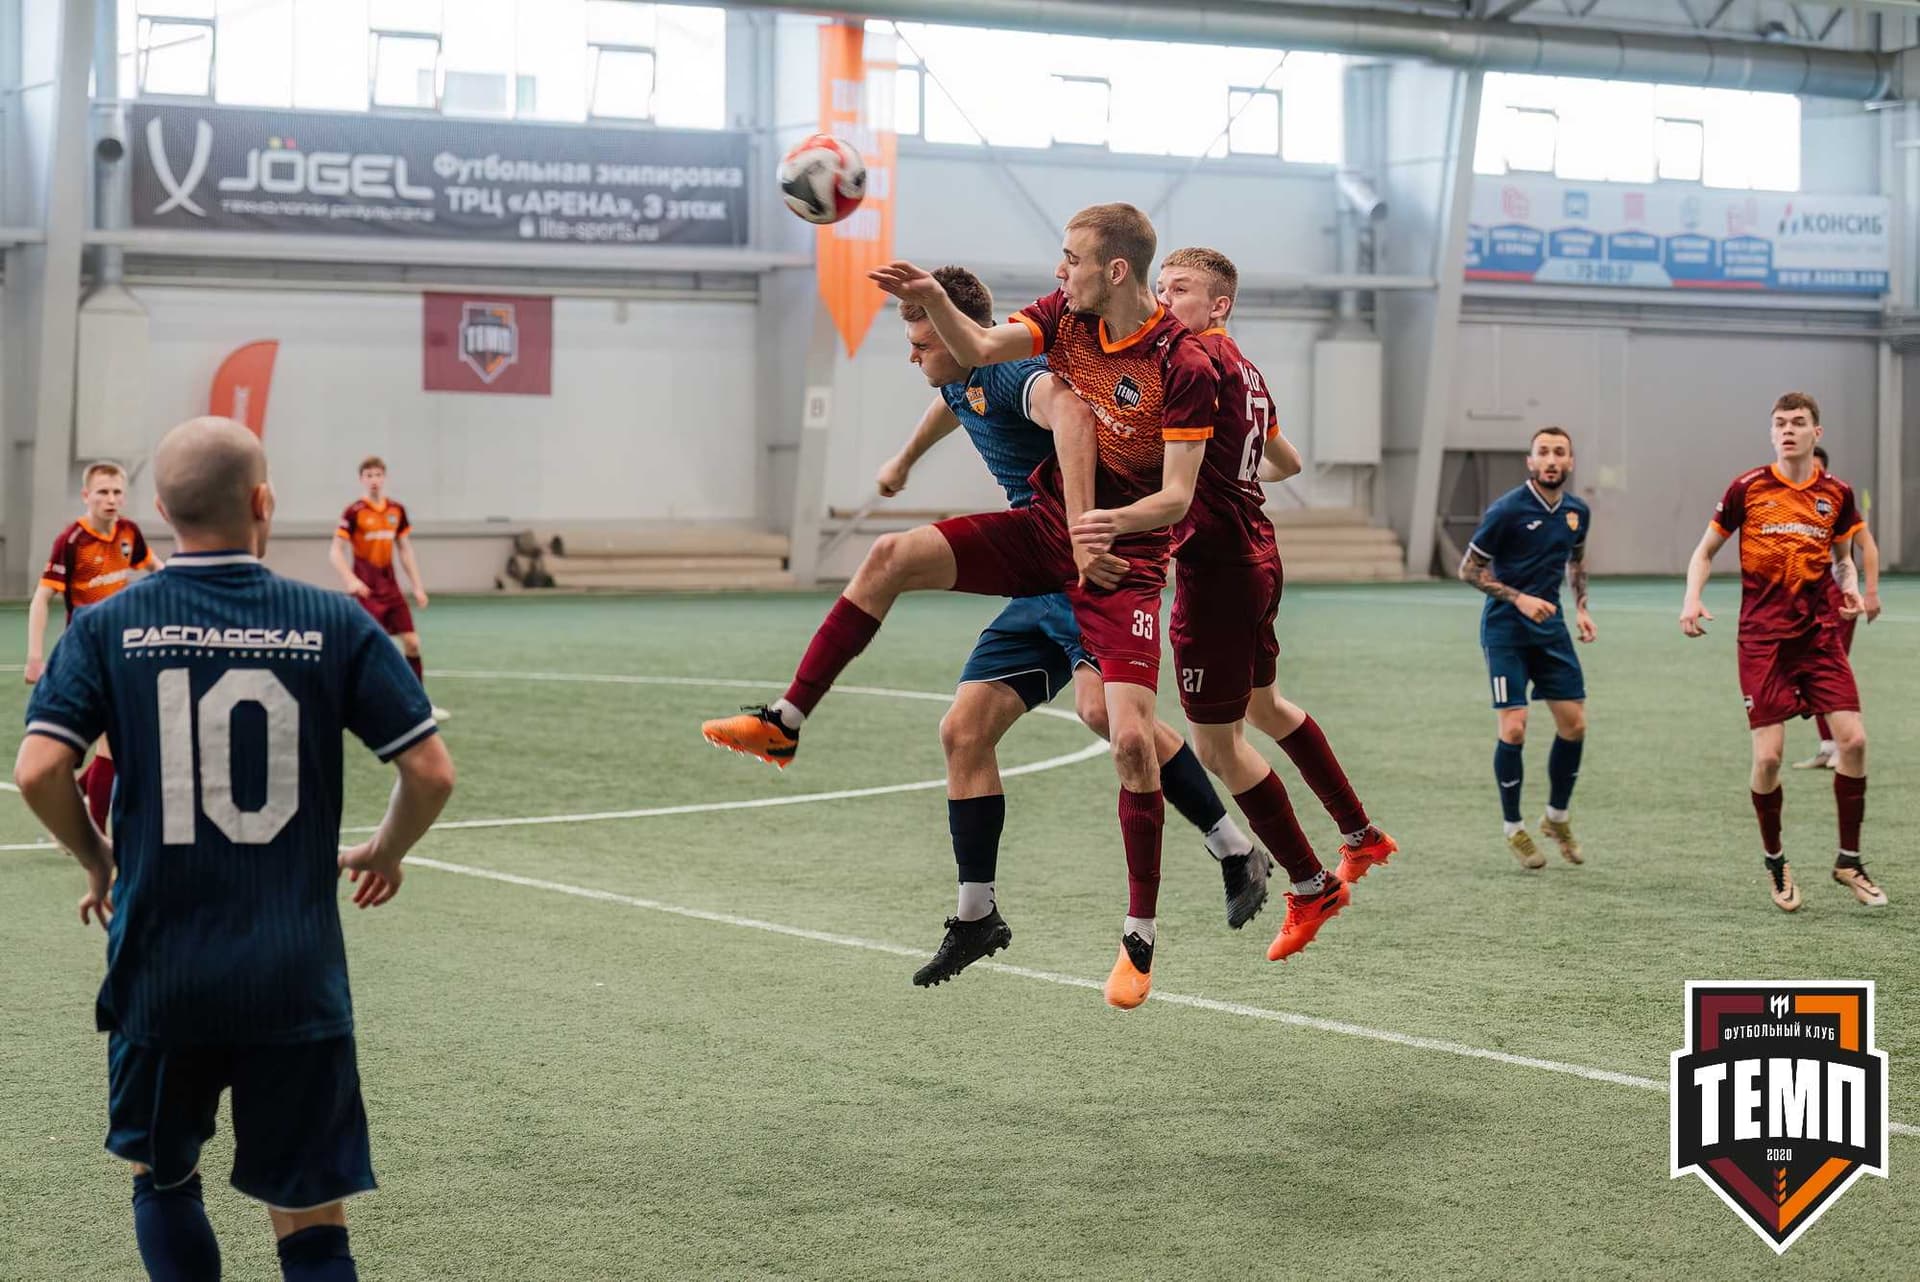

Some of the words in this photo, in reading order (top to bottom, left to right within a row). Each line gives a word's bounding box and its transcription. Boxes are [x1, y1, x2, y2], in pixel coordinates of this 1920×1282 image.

[218, 136, 435, 199] JÖGEL
[433, 152, 592, 184] Футбольная
[596, 164, 743, 192] экипировка
[446, 186, 503, 218] ТРЦ
[643, 194, 663, 219] 3
[665, 201, 727, 220] этаж
[1802, 213, 1882, 236] КОНСИБ
[1117, 385, 1139, 406] ТЕМП
[1131, 609, 1153, 640] 33
[1182, 668, 1204, 693] 27
[1493, 676, 1507, 703] 11
[157, 667, 300, 845] 10
